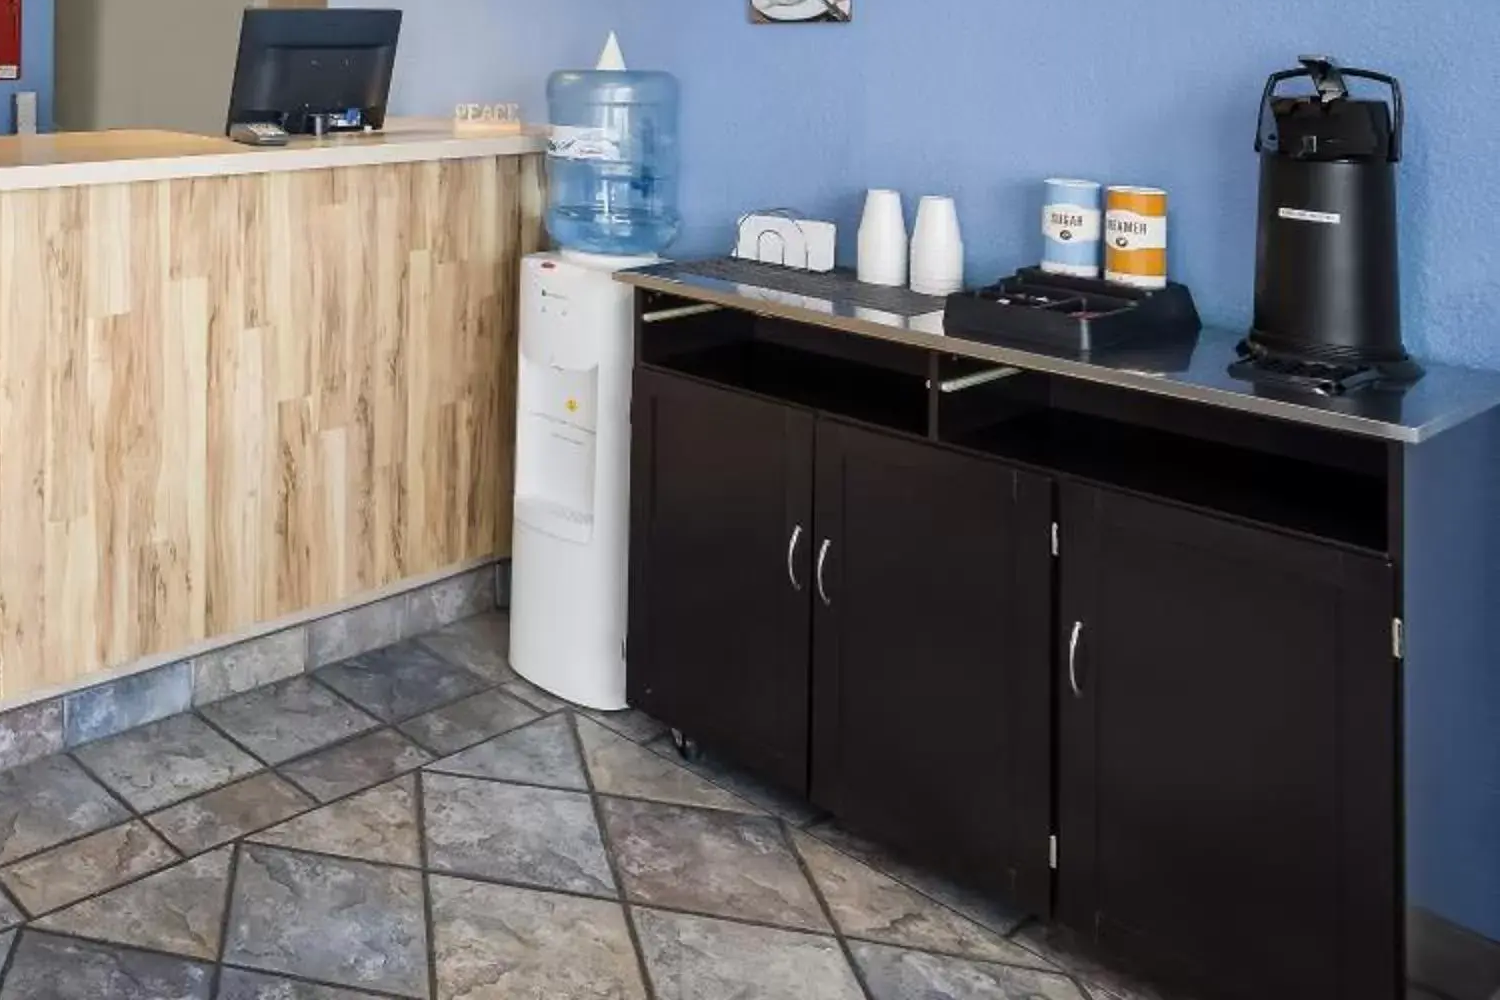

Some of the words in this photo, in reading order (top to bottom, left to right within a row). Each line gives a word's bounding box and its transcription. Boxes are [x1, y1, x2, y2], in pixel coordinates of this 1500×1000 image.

[455, 102, 520, 122] PEACE
[1051, 215, 1083, 227] SUGAR
[1107, 218, 1147, 235] REAMER
